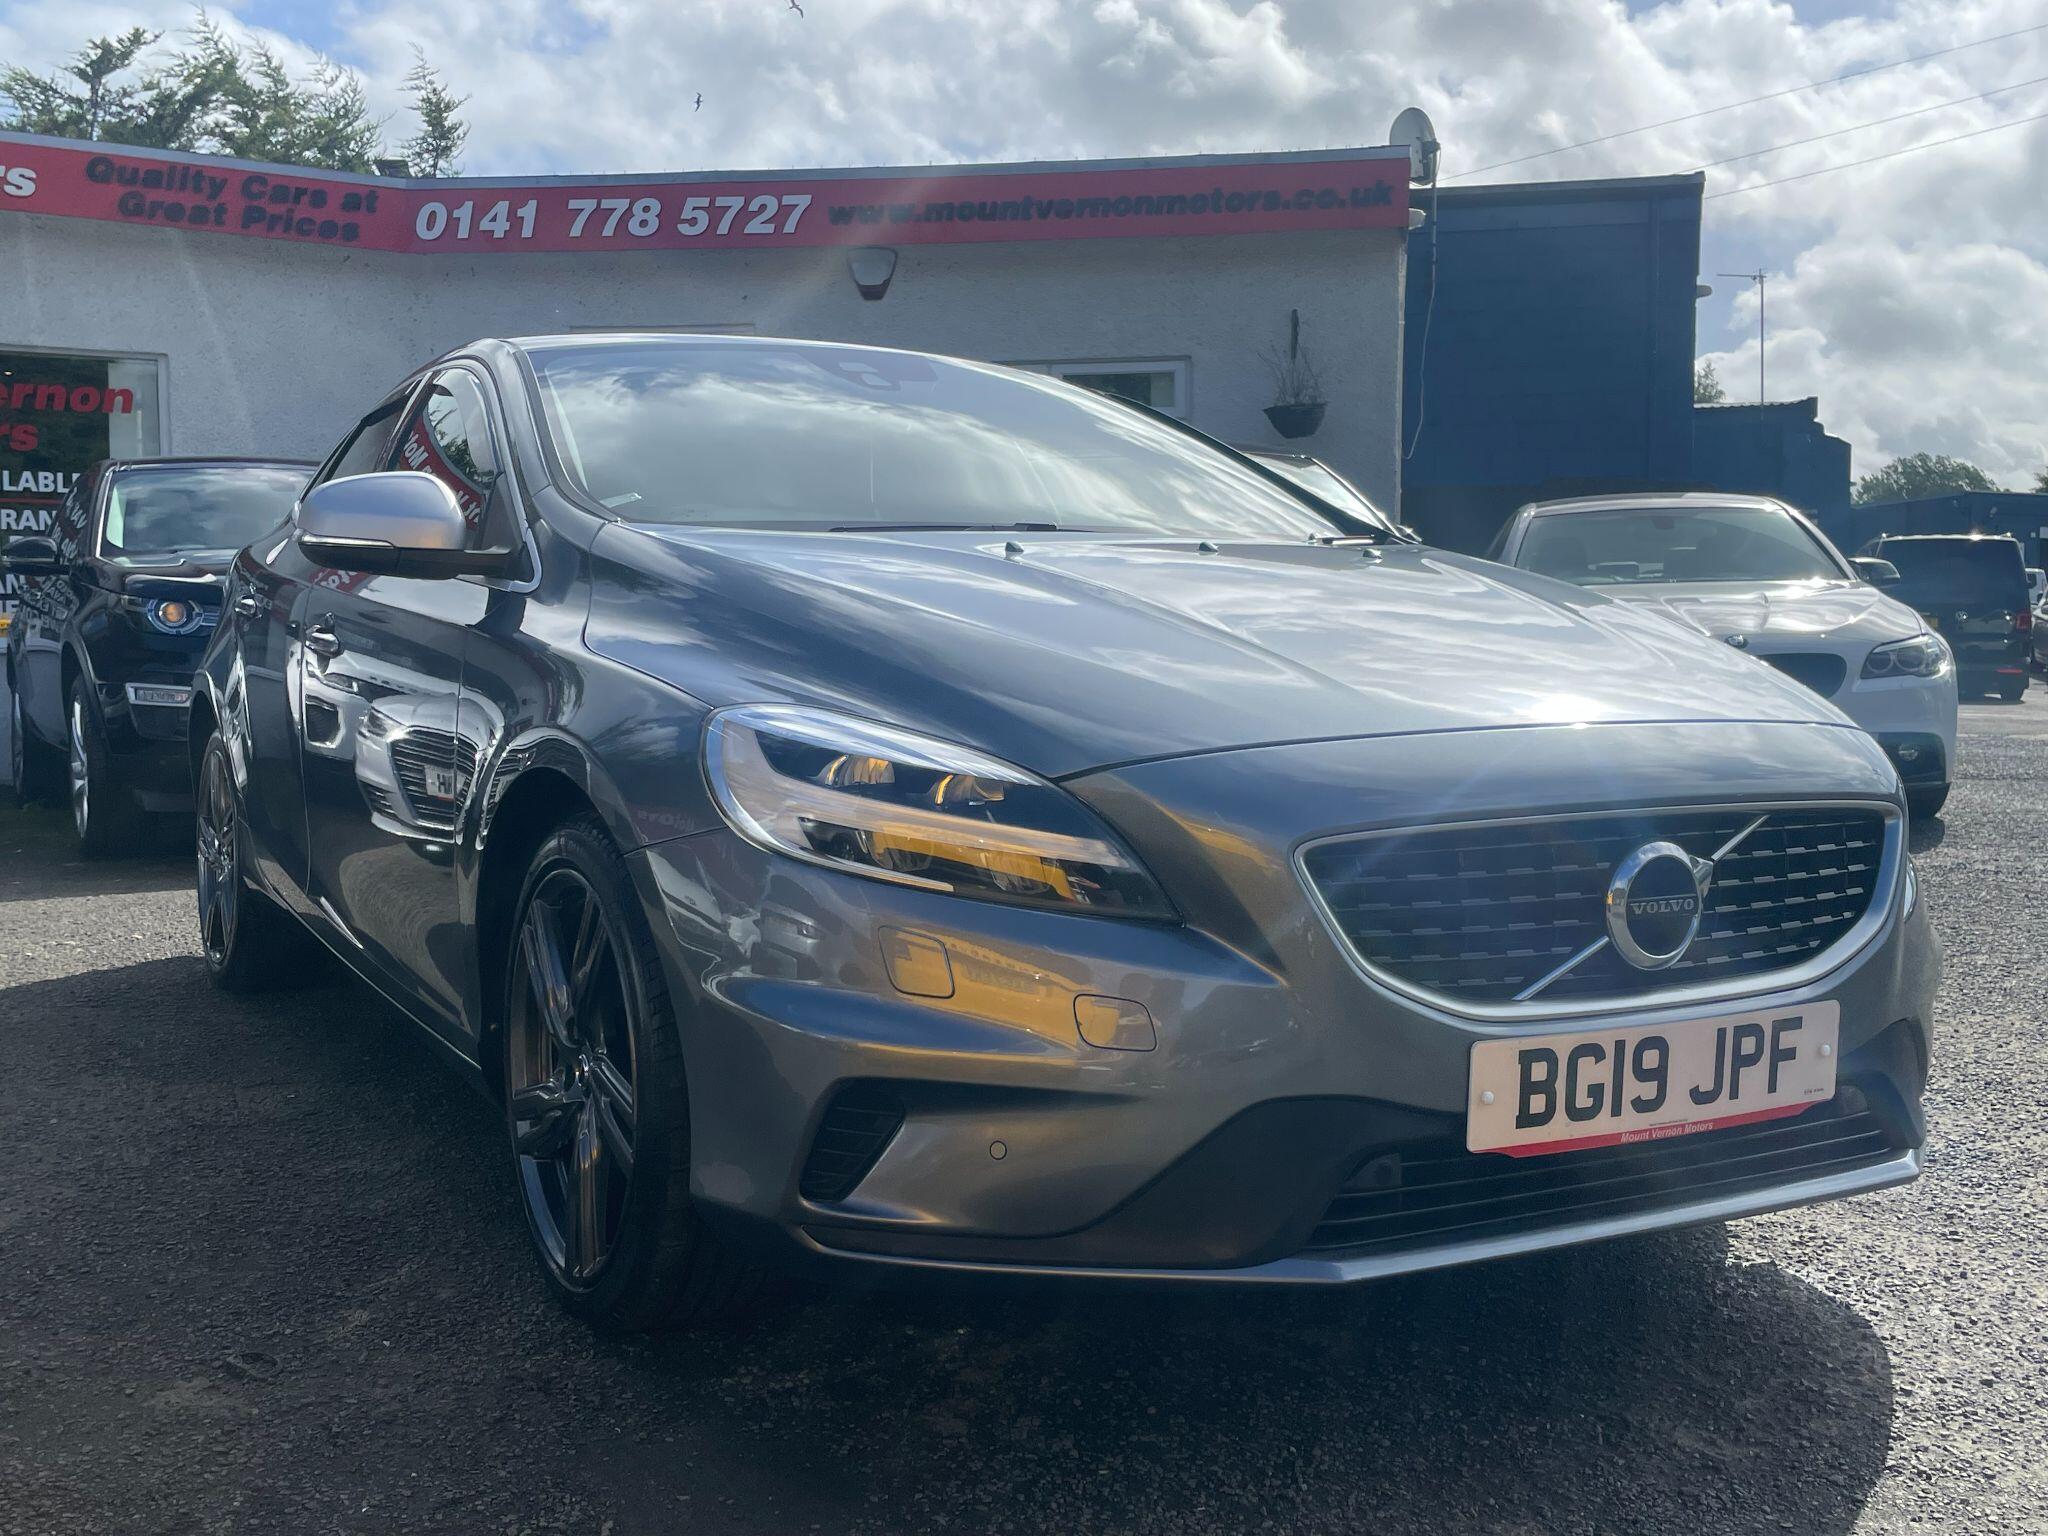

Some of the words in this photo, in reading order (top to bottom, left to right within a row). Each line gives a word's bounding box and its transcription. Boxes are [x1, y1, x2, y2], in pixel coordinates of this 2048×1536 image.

[86, 155, 228, 201] Quality
[241, 174, 328, 210] Cars
[342, 189, 379, 214] at
[828, 179, 1395, 226] www.mountvernonmotors.co.uk
[118, 190, 229, 227] Great
[241, 204, 360, 243] Prices
[415, 199, 538, 241] 0141
[568, 197, 661, 238] 778
[677, 194, 812, 236] 5727
[2, 470, 80, 494] LABL
[1630, 898, 1695, 915] VOLVO
[1515, 1034, 1670, 1130] BG19
[1688, 1015, 1804, 1107] JPF
[1620, 1131, 1650, 1144] Mount
[1651, 1126, 1682, 1139] Vernon
[1684, 1121, 1714, 1135] Motors
